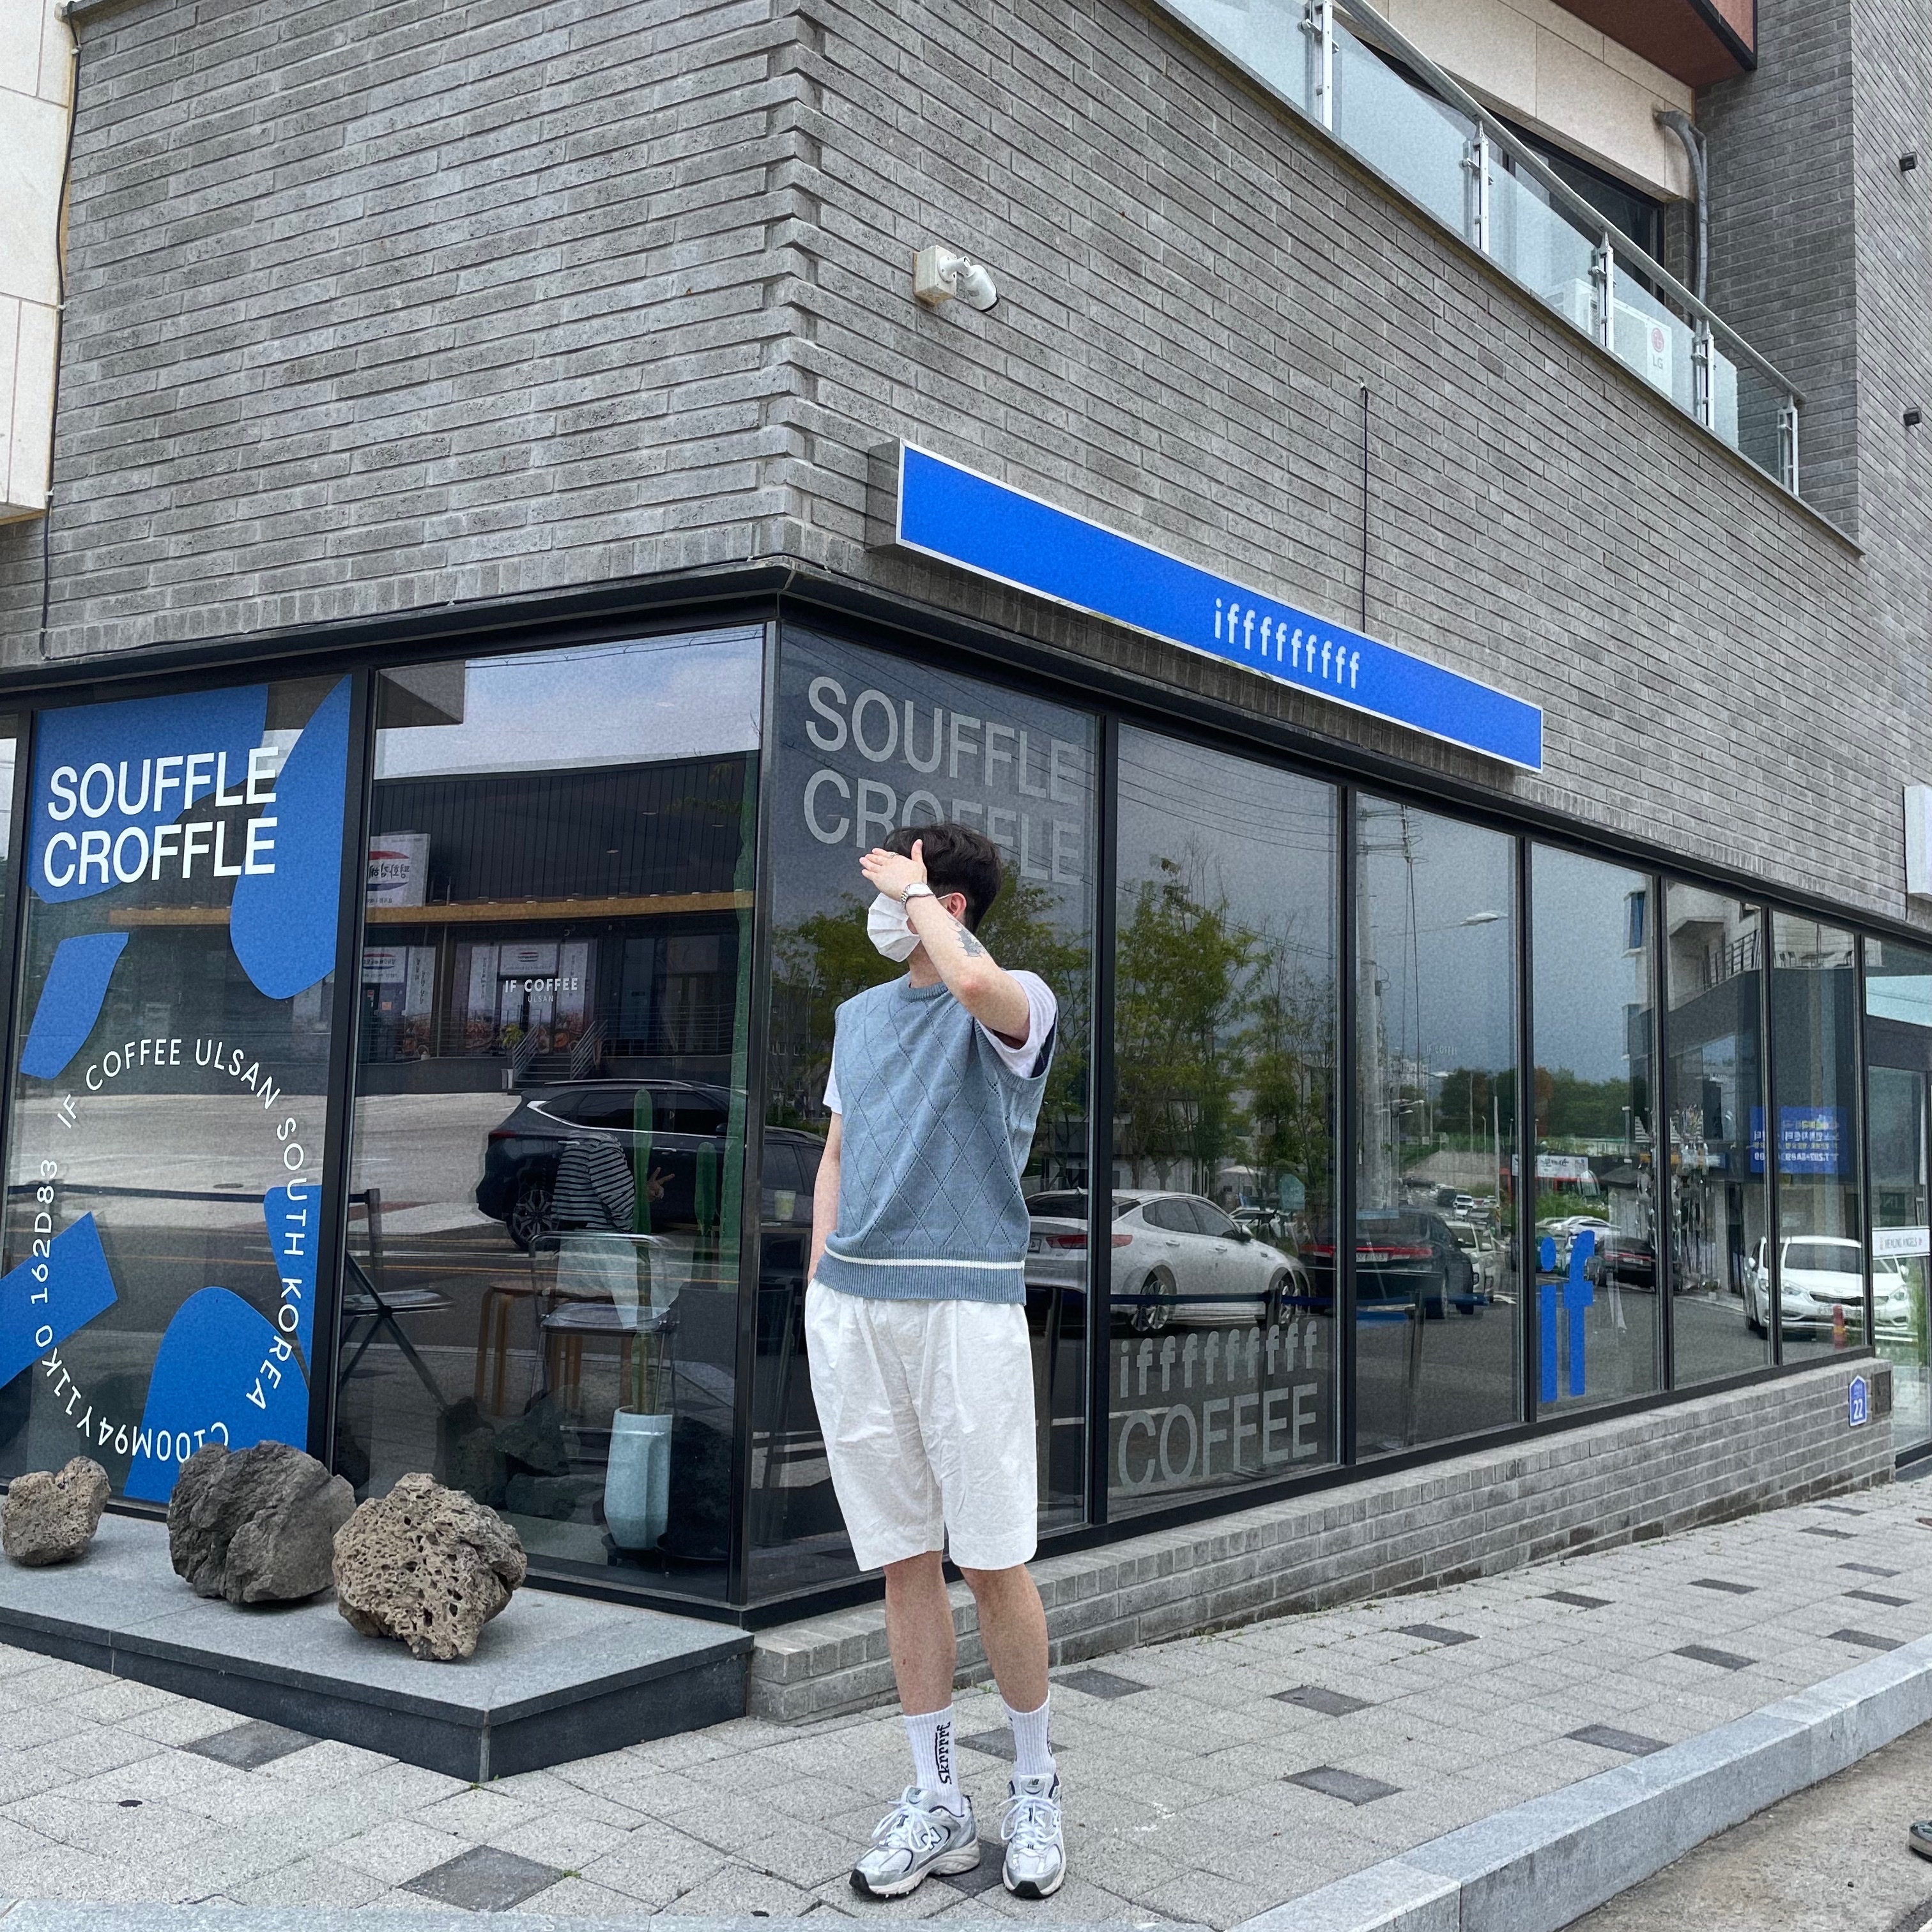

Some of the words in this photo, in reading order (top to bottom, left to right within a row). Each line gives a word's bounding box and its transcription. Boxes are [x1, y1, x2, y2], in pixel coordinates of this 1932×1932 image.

[1652, 354, 1664, 370] LG
[805, 676, 1080, 806] SOUFFLE
[48, 746, 279, 822] SOUFFLE
[43, 817, 278, 887] CROFFLE
[504, 980, 517, 993] IF
[524, 977, 578, 992] COFFEE
[528, 995, 555, 1004] ULSAN
[86, 1039, 181, 1090] COFFEE
[195, 1039, 280, 1109] ULSAN
[57, 1094, 76, 1128] IF
[277, 1117, 308, 1255] SOUTH
[31, 1160, 57, 1304] 162D83
[246, 1278, 303, 1410] KOREA
[1540, 1230, 1595, 1403] if
[1117, 1382, 1318, 1491] COFFEE
[1853, 1398, 1863, 1420] 22
